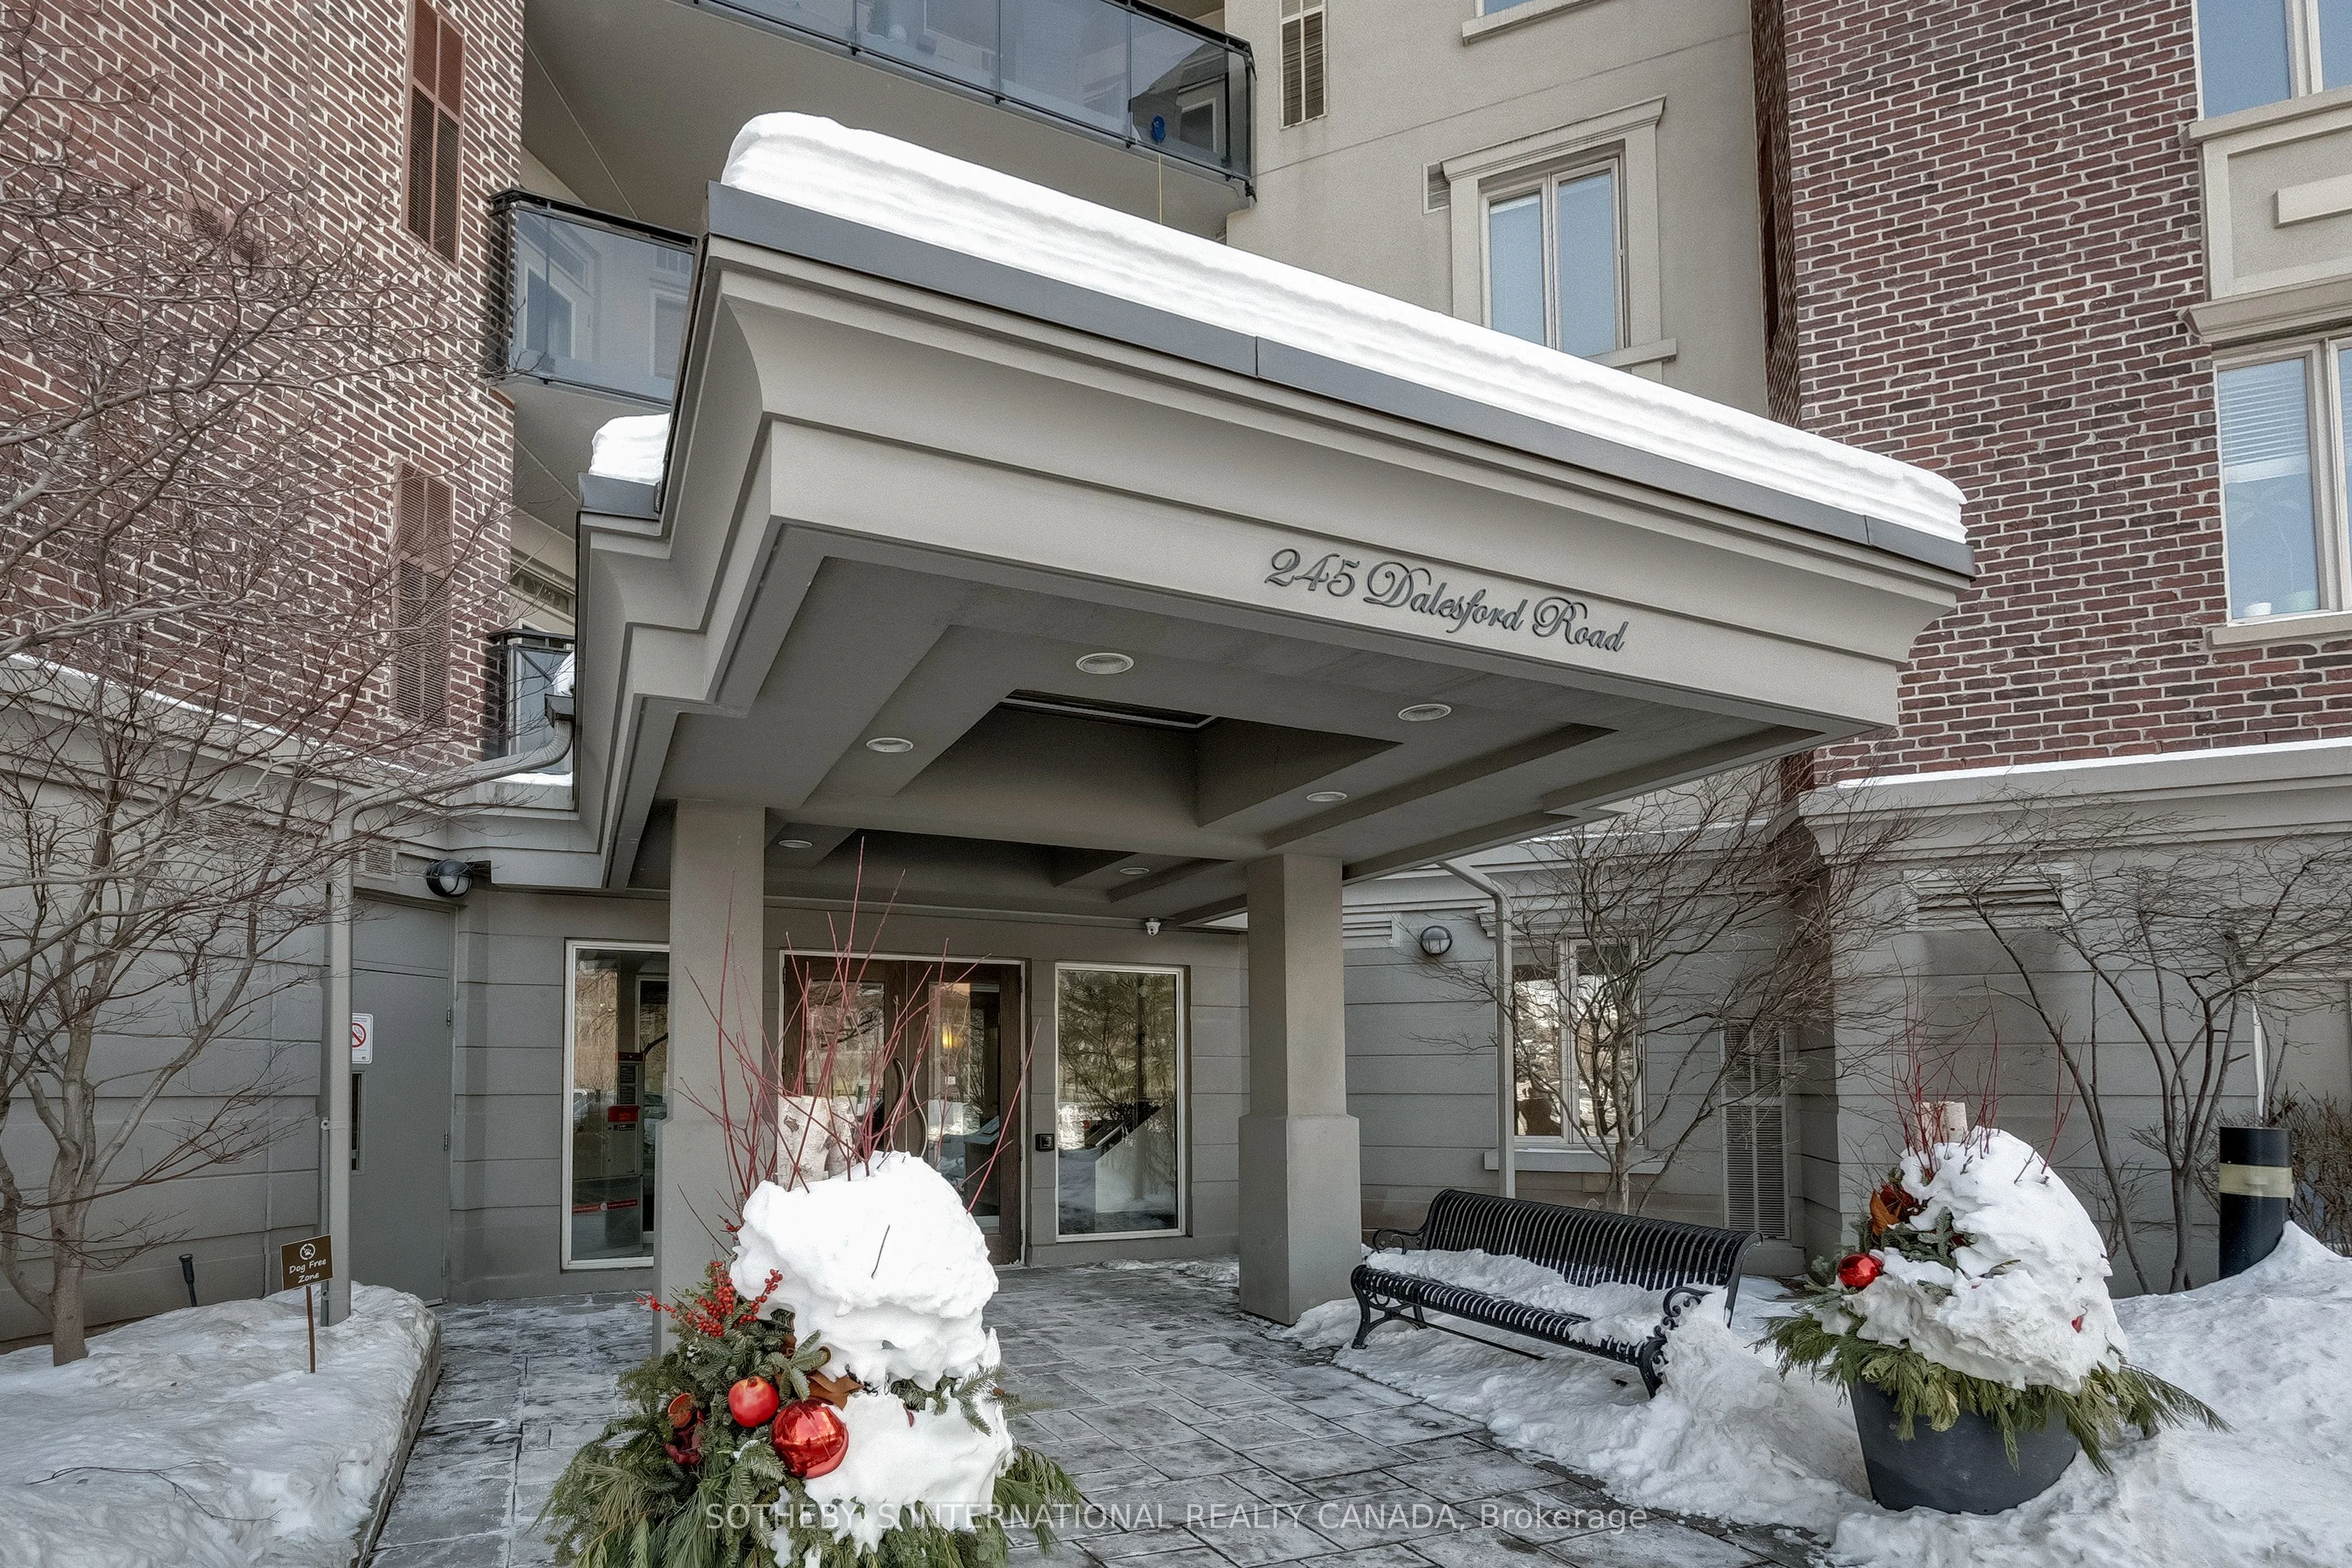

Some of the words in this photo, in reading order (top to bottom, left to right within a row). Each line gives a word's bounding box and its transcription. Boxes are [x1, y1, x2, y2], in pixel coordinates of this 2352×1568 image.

[1265, 548, 1360, 597] 245
[1363, 560, 1528, 634] Dalesford
[1532, 596, 1630, 652] Road
[289, 1265, 306, 1274] Dog
[309, 1259, 327, 1269] Free
[297, 1272, 320, 1283] Zone
